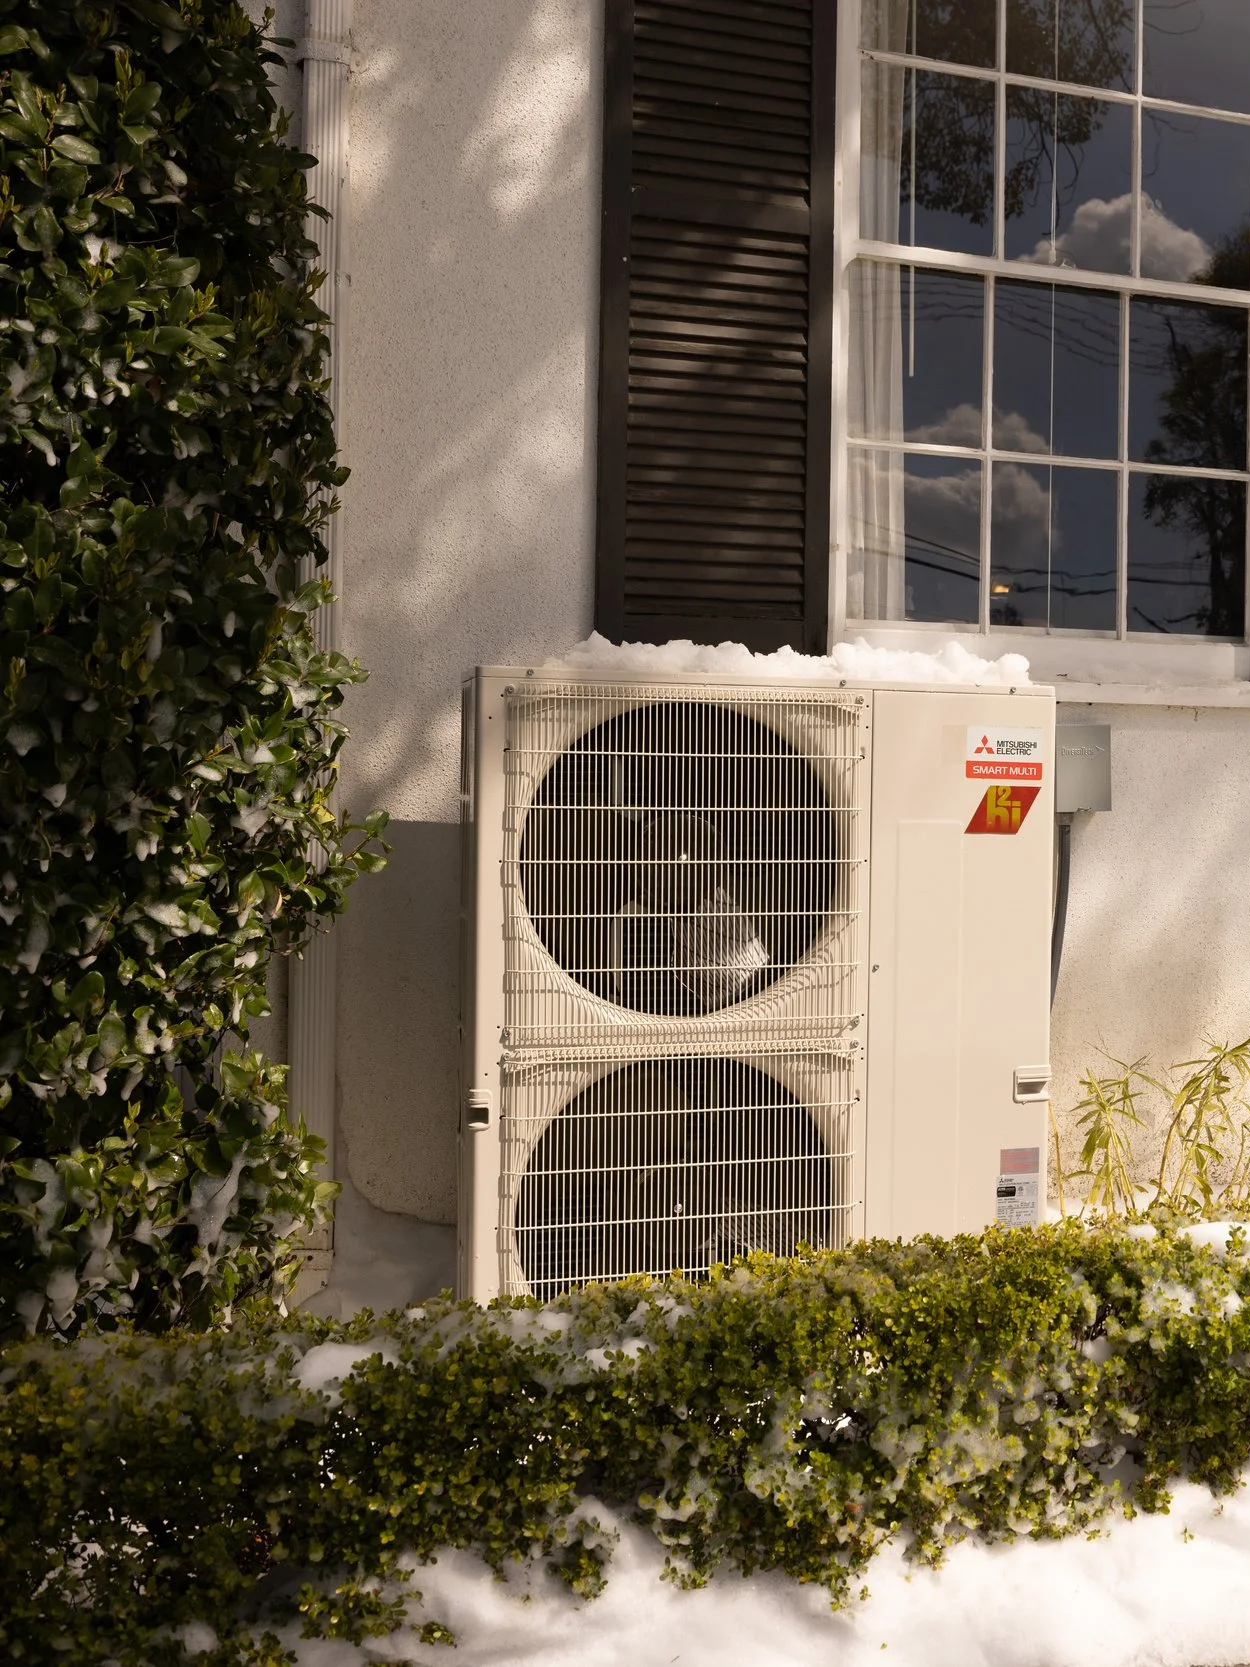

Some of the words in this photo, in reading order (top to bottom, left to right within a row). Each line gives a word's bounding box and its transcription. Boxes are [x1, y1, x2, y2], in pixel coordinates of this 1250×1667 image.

[996, 740, 1037, 749] MITSUBISHI
[996, 748, 1032, 756] ELECTRIC
[972, 765, 1008, 775] SMART
[1009, 767, 1037, 776] MULTI
